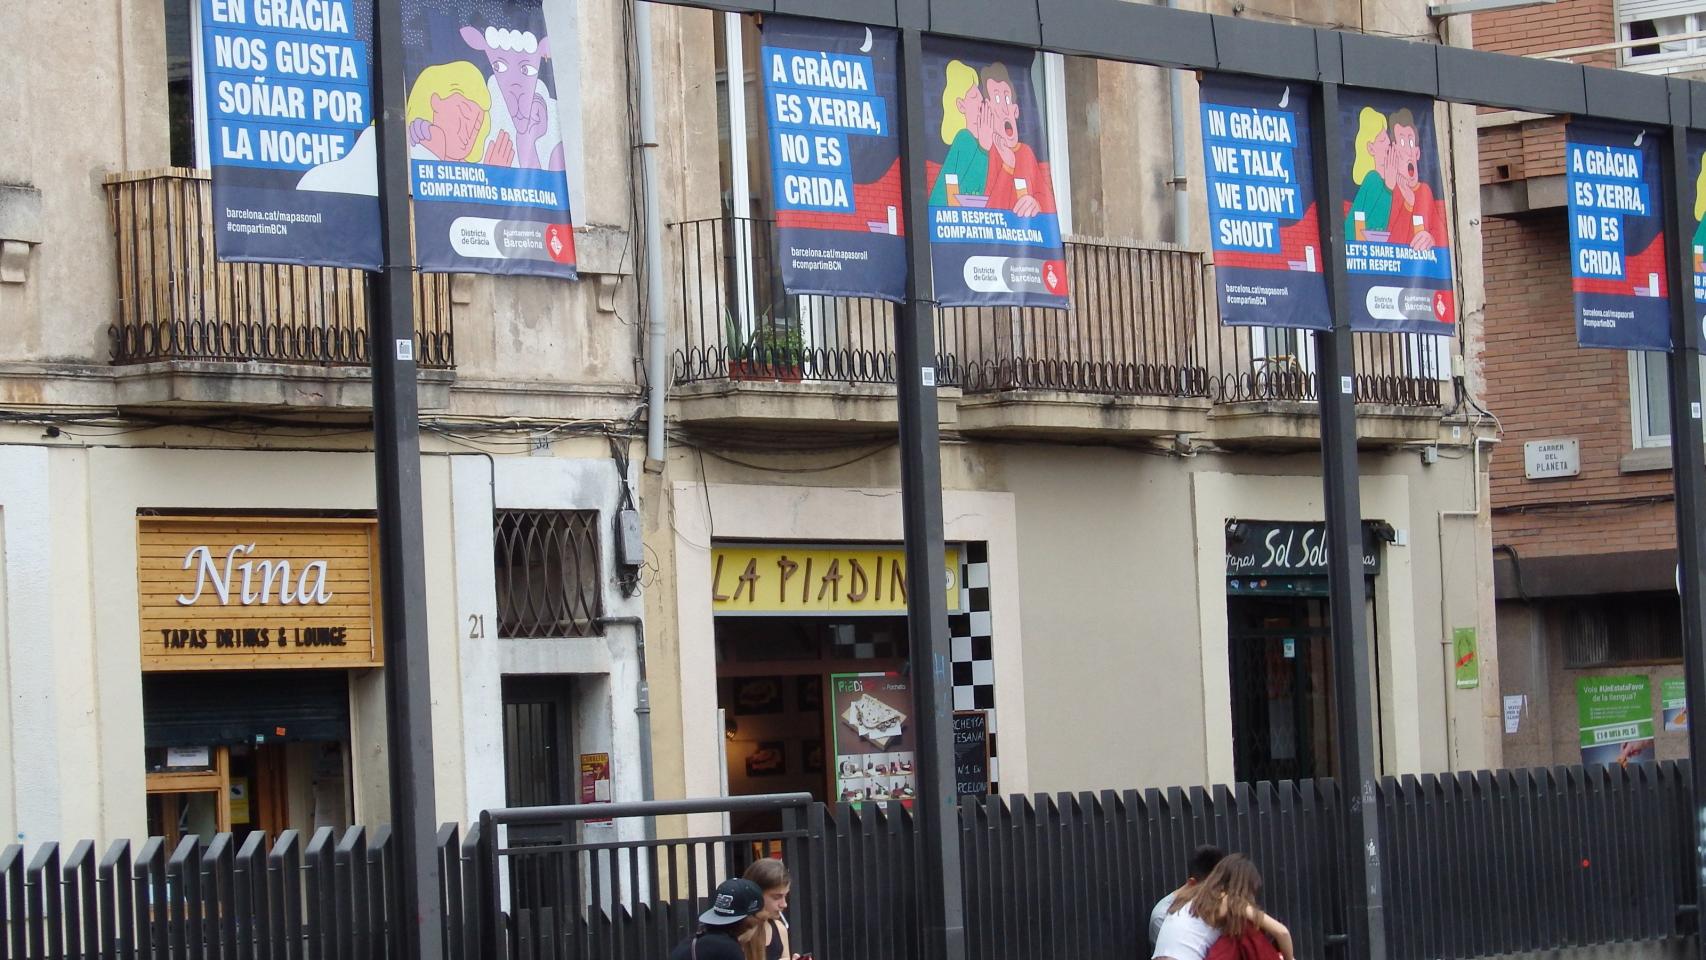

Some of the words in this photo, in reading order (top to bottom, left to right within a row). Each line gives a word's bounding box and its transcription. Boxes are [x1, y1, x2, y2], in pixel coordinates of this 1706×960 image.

[212, 0, 246, 24] EN
[215, 36, 268, 71] NOS
[276, 41, 358, 79] GUSTA
[773, 55, 788, 84] A
[791, 52, 868, 91] GRÀCIA
[218, 76, 306, 119] SOÑAR
[313, 89, 363, 123] POR
[776, 94, 803, 124] ES
[807, 96, 880, 135] XERRA,
[1208, 110, 1226, 136] IN
[1230, 108, 1291, 143] GRÀCIA
[222, 127, 254, 160] LA
[260, 130, 345, 165] NOCHE
[781, 134, 810, 164] NO
[815, 137, 842, 167] ES
[419, 165, 433, 179] EN
[438, 166, 489, 185] SILENCIO,
[1212, 146, 1239, 174] WE
[1241, 149, 1289, 183] TALK,
[1574, 149, 1584, 173] A
[1586, 147, 1638, 178] GRÀCIA
[420, 182, 498, 201] COMPARTIMOS
[501, 188, 557, 206] BARCELONA
[785, 175, 849, 208] CRIDA
[1215, 183, 1242, 210] WE
[1576, 182, 1593, 206] ES
[1596, 184, 1645, 214] XERRA,
[227, 208, 322, 224] barcelona.cat/mapasoroll
[227, 222, 287, 235] #compartimBCN
[936, 211, 959, 223] AMB
[962, 211, 1007, 227] RESPECTE,
[1578, 215, 1596, 240] NO
[1601, 217, 1618, 242] ES
[461, 229, 486, 238] Districte
[504, 238, 543, 249] Barcelona
[937, 226, 994, 240] COMPARTIM
[996, 228, 1043, 243] BARCELONA
[1220, 219, 1273, 248] SHOUT
[791, 247, 868, 260] barcelona.cat/mapasoroll
[1346, 258, 1367, 270] WITH
[1370, 259, 1401, 272] RESPECT
[1370, 245, 1394, 258] SHARE
[1580, 249, 1622, 276] CRIDA
[793, 260, 842, 271] #compartimBCN
[1537, 461, 1568, 472] PLANETA
[1262, 529, 1294, 568] Sol
[1296, 529, 1328, 568] Sol
[712, 555, 760, 602] LA
[777, 556, 908, 604] PIADIN
[162, 628, 208, 649] TAPAS
[216, 628, 270, 648] DRINKS
[278, 627, 287, 647] &
[295, 627, 347, 647] LOUNGE
[469, 614, 485, 639] 21
